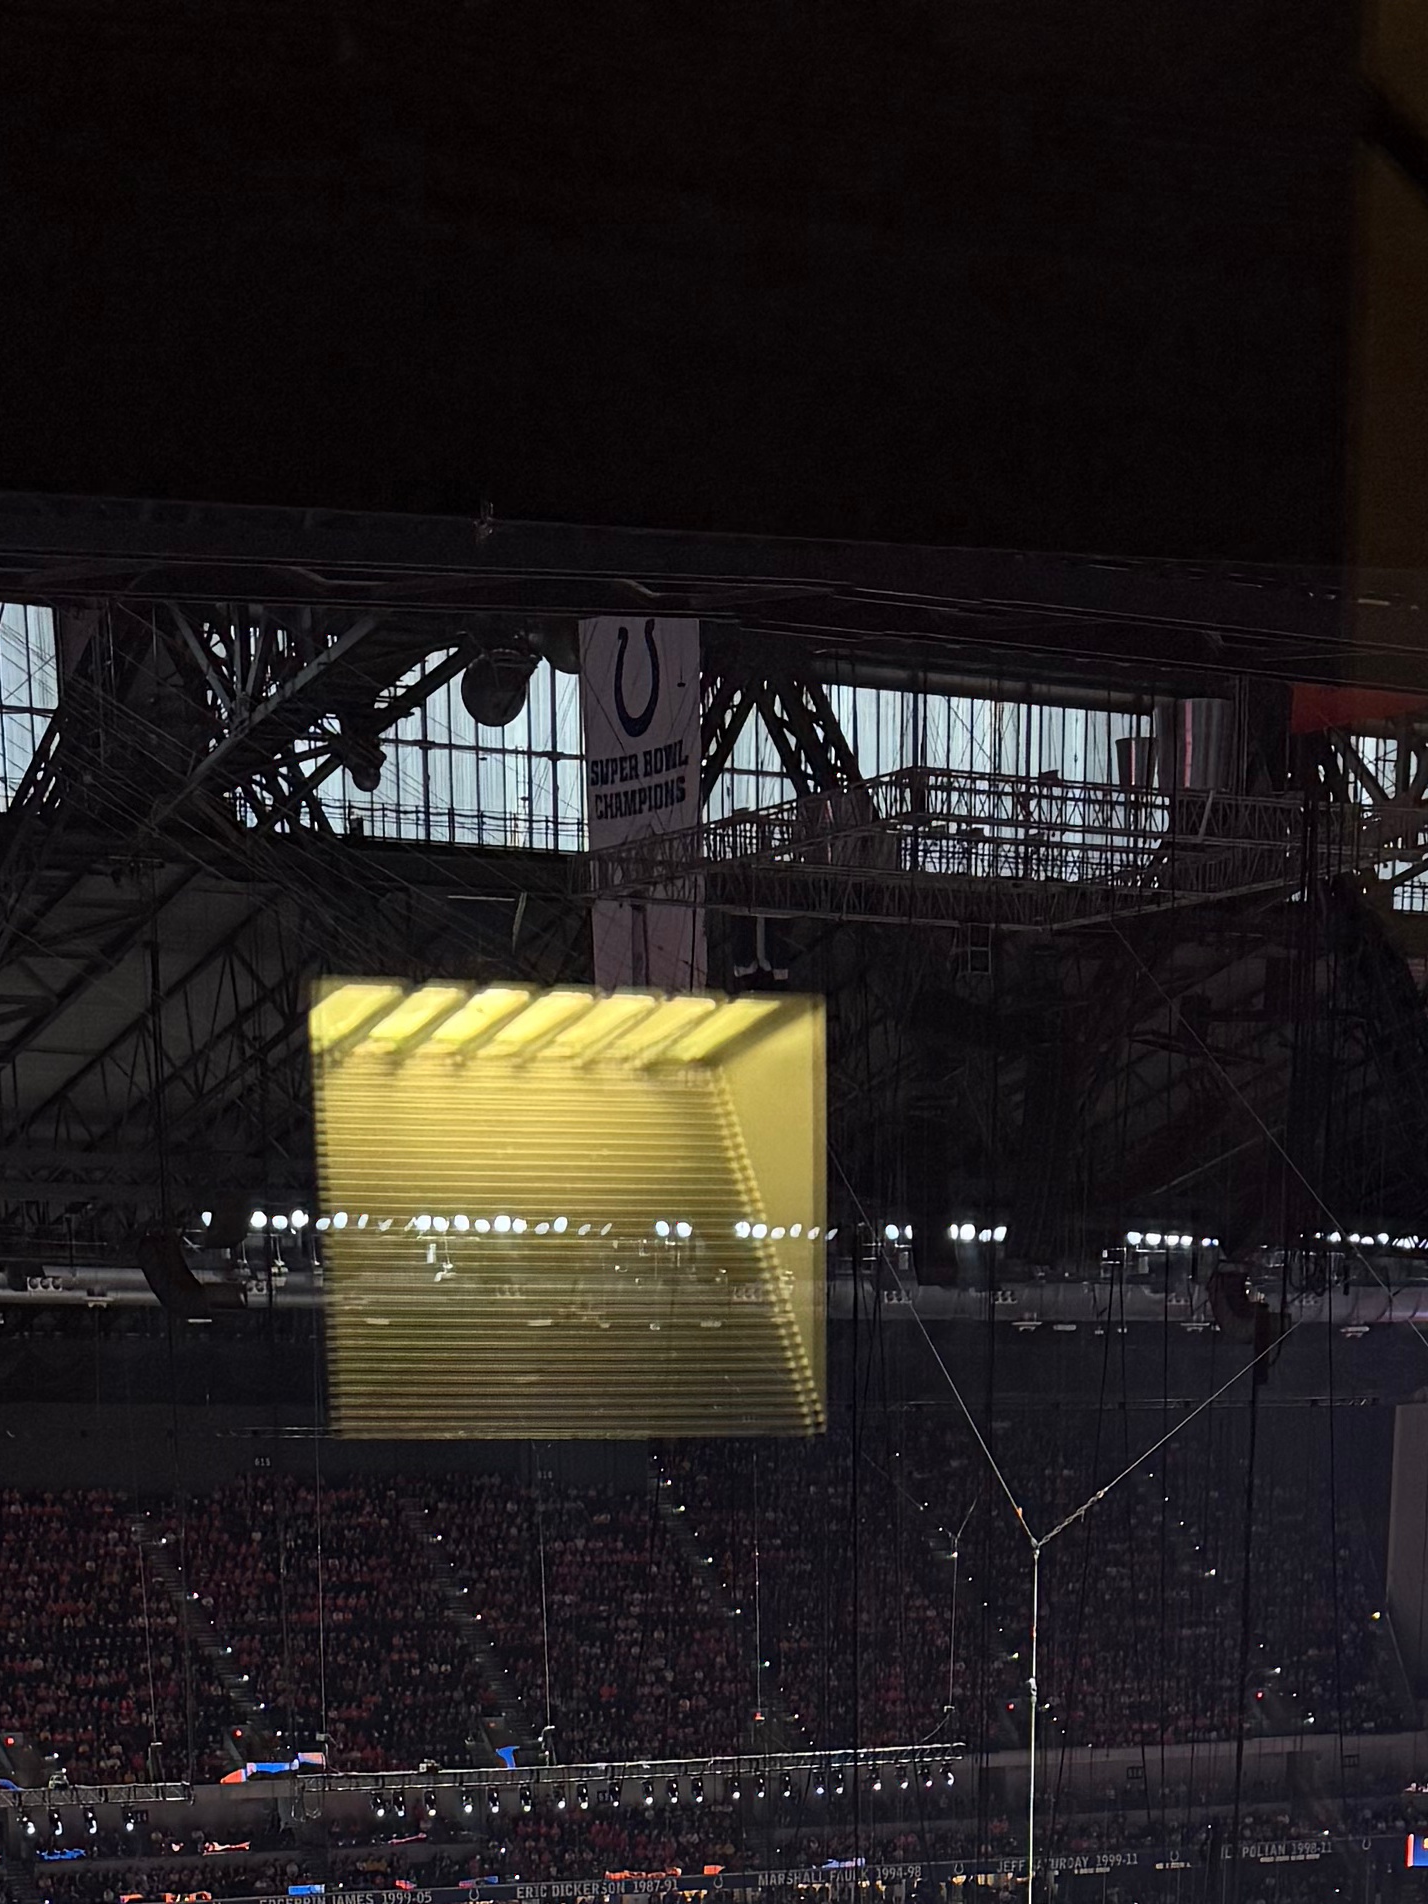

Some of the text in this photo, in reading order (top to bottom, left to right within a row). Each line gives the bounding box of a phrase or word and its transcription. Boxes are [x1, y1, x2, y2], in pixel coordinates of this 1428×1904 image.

[591, 739, 689, 786] SUPER BOWL
[595, 776, 686, 820] CHAMPIONS
[996, 1852, 1139, 1874] JEFF 1999-11
[758, 1865, 922, 1887] MARSHALL 1994-98
[516, 1878, 679, 1900] ERIC DICKERSON 1987-91
